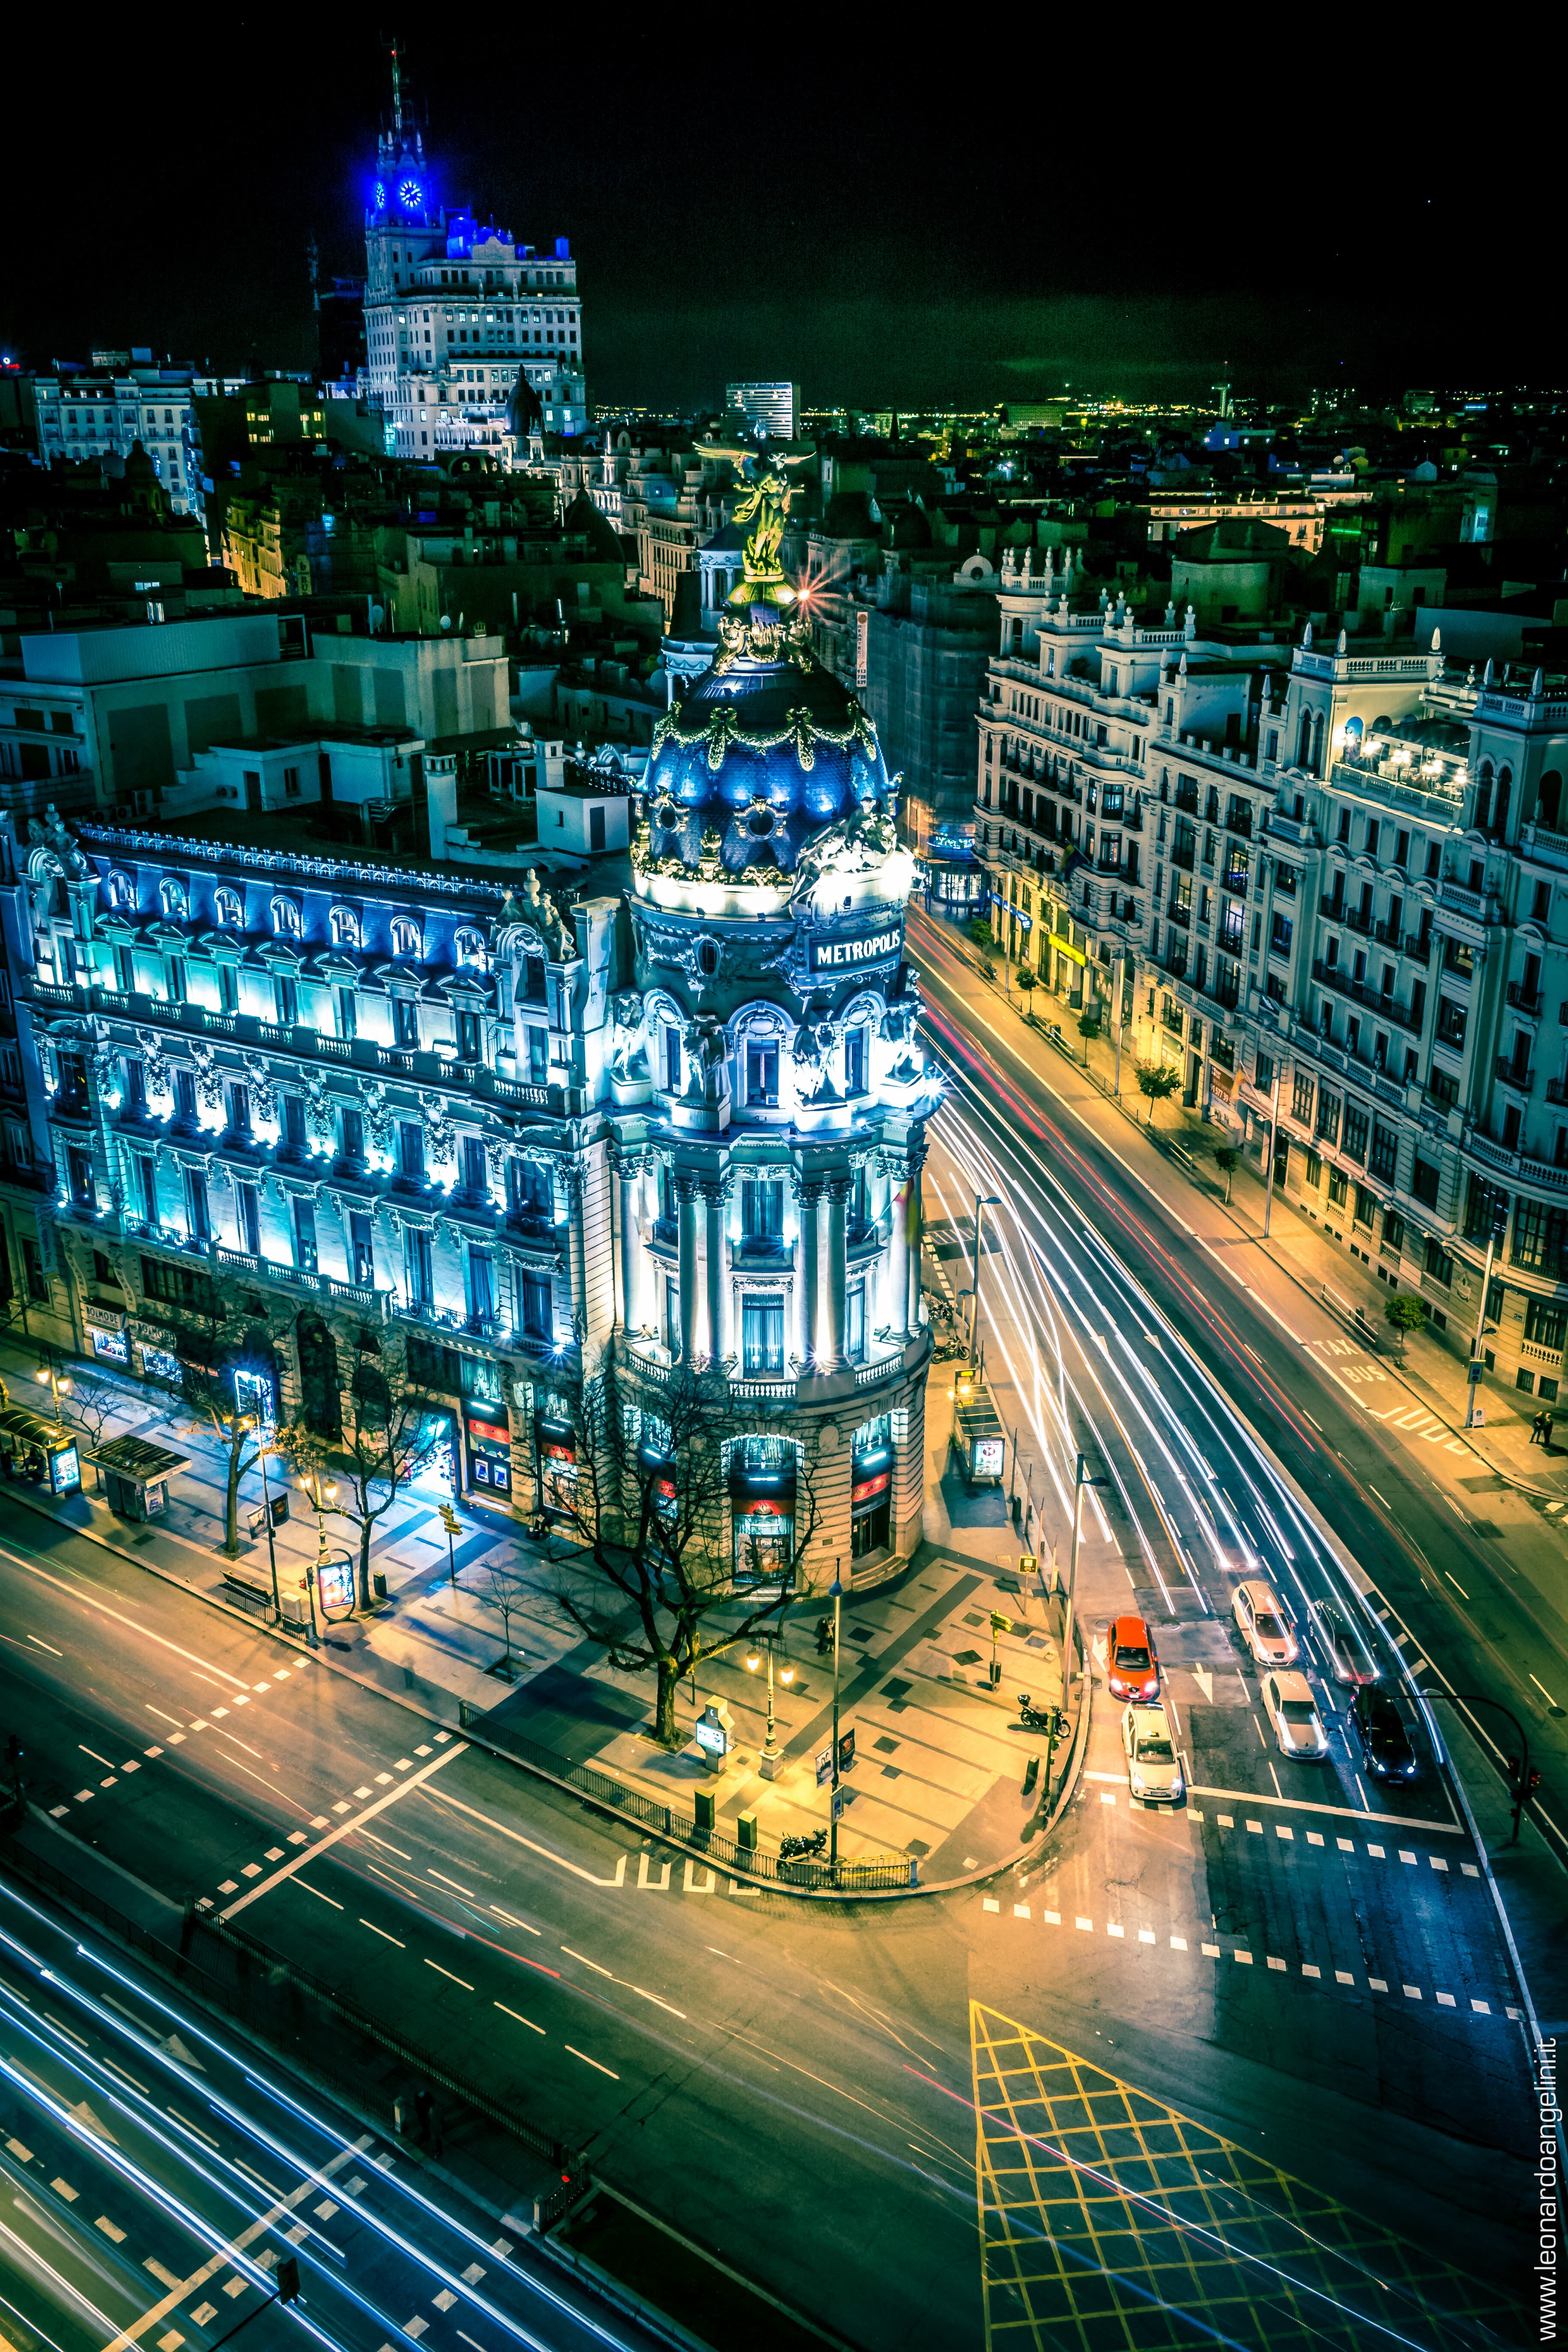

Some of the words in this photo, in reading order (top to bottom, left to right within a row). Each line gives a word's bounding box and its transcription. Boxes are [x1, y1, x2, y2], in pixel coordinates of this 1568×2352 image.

[818, 929, 900, 965] METROPOLIS
[1312, 1339, 1365, 1356] TAXI
[1340, 1366, 1387, 1383] BUS
